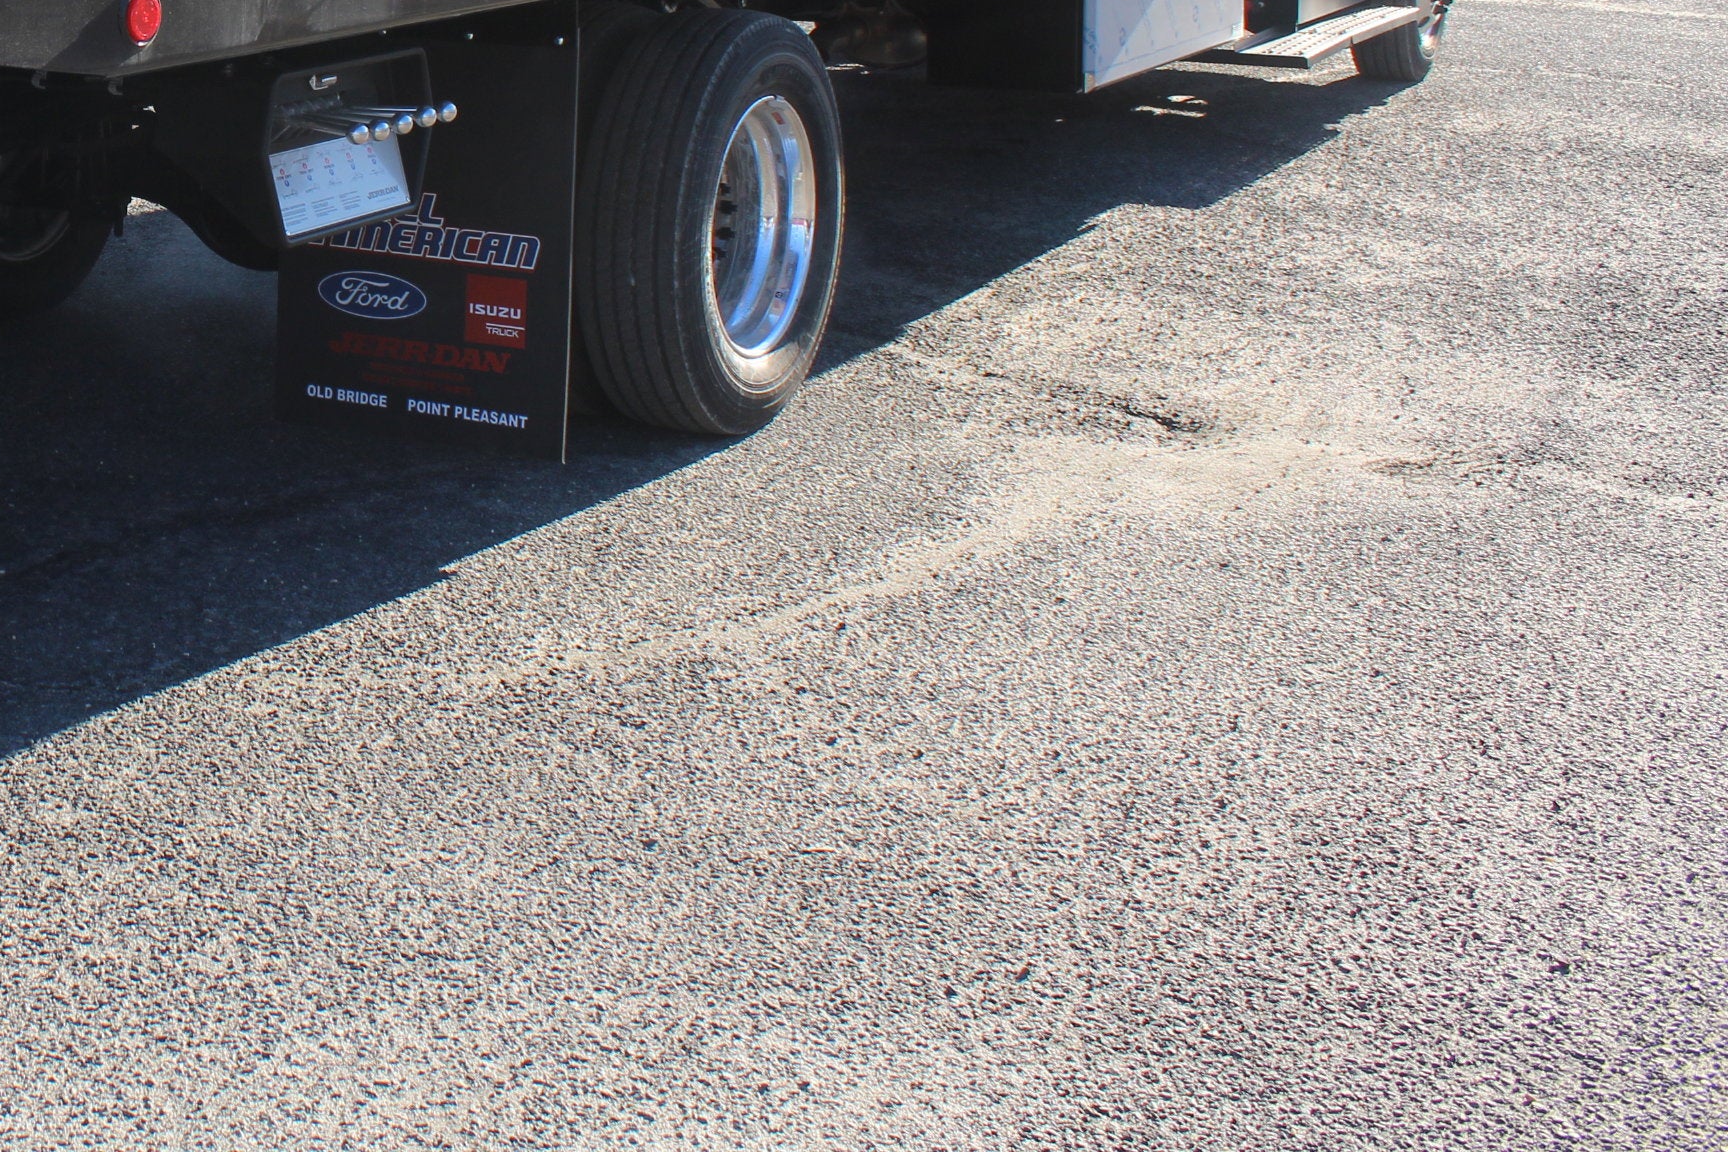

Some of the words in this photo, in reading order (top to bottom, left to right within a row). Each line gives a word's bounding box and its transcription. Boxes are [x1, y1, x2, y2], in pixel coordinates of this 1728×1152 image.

[307, 218, 541, 270] MERICAN
[335, 276, 409, 312] Ford
[469, 302, 522, 320] ISUZU
[485, 325, 519, 339] TRUCK
[306, 384, 333, 399] OLD
[337, 388, 388, 408] BRIDGE
[407, 398, 451, 417] POINT
[454, 405, 529, 429] PLEASANT
